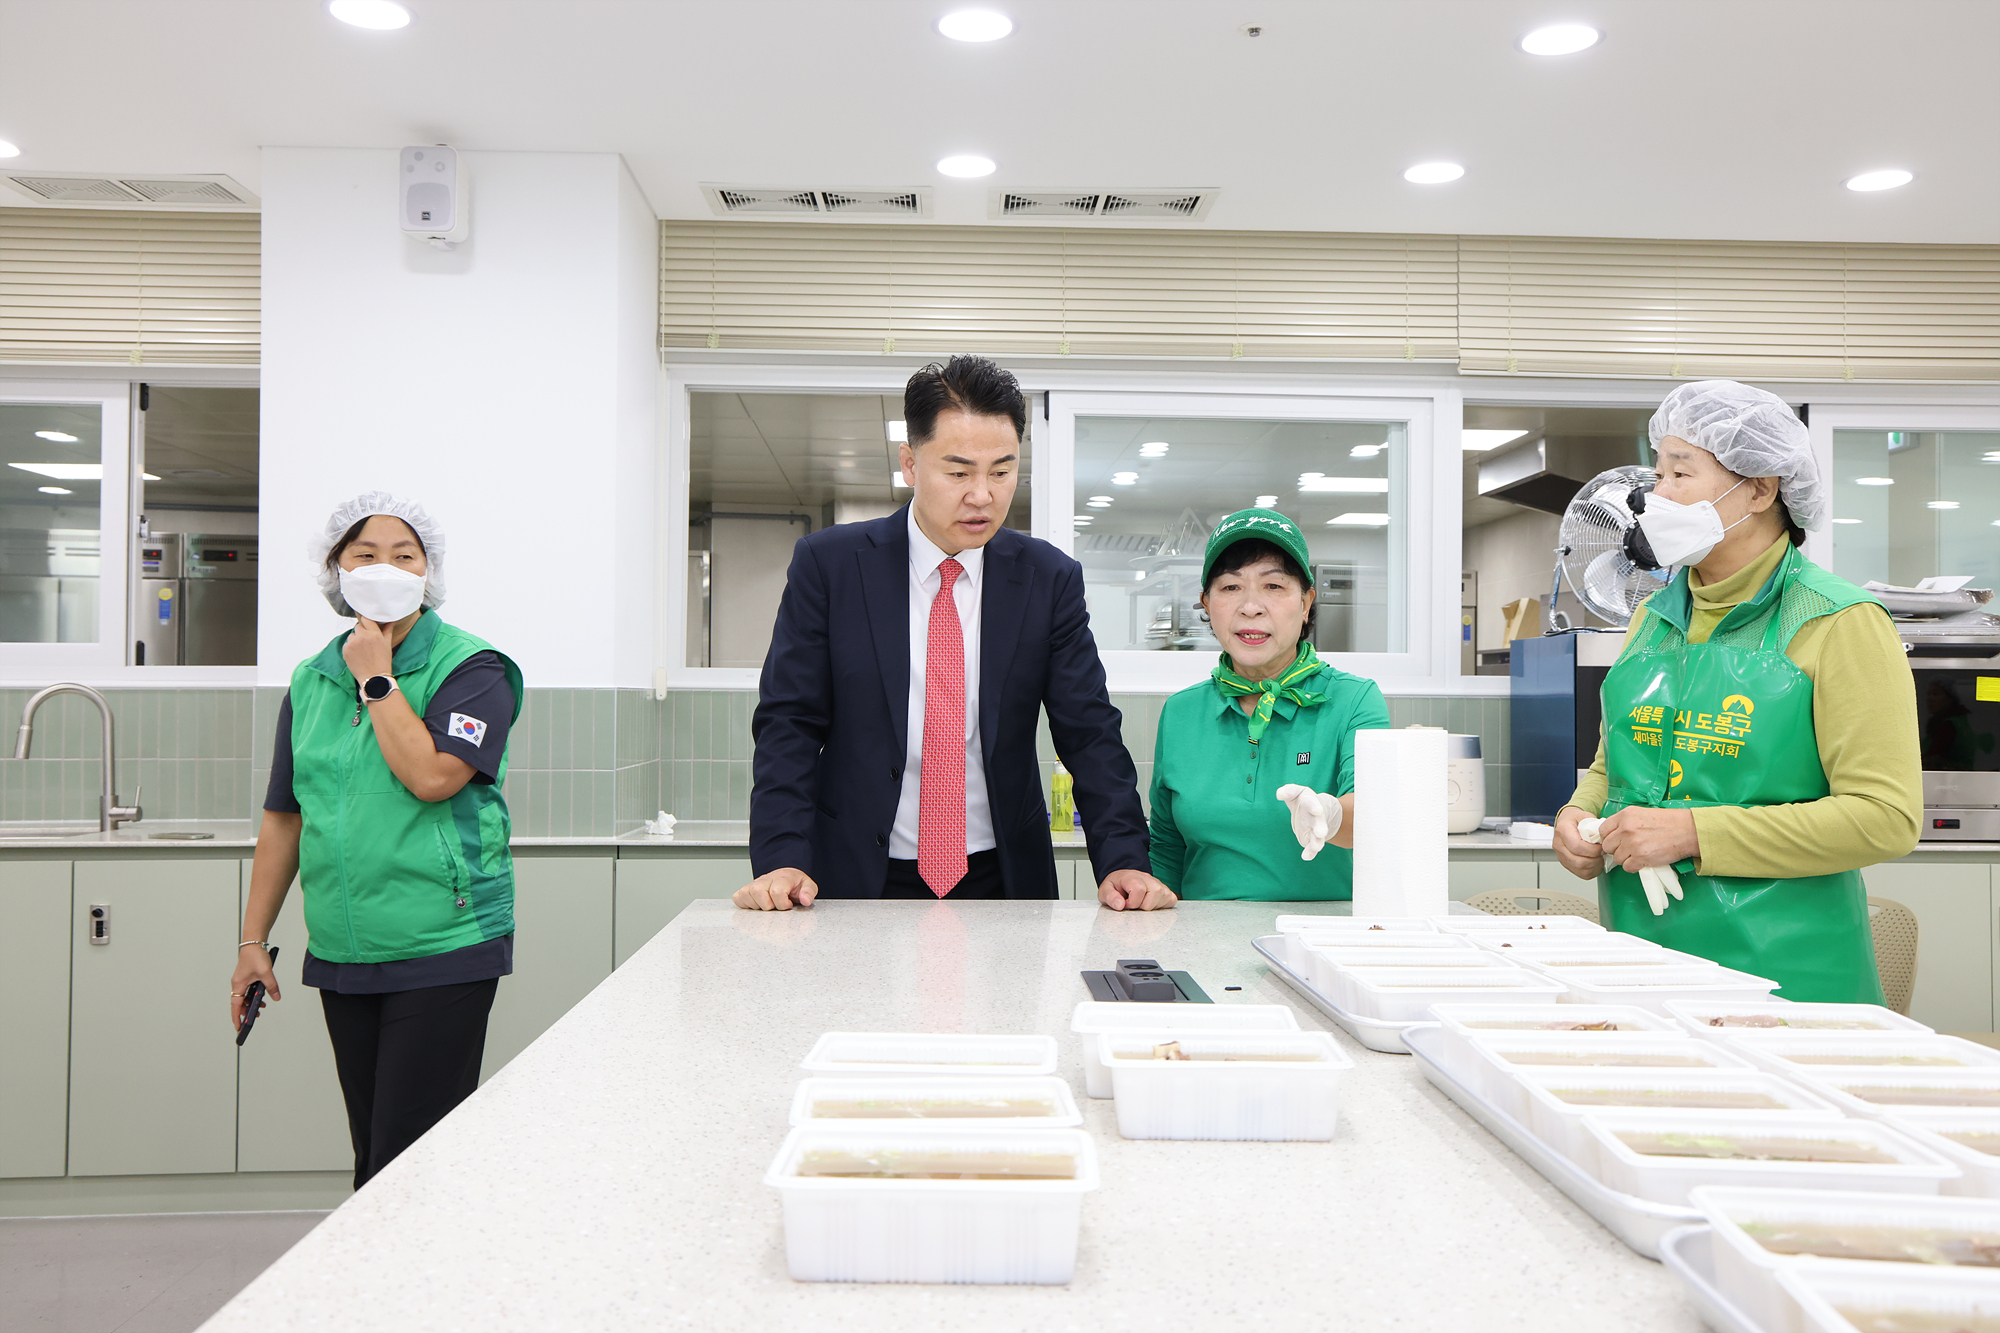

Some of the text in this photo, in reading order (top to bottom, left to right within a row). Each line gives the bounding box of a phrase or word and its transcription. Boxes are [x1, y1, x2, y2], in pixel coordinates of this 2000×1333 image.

[1213, 518, 1245, 539] New
[1628, 705, 1752, 738] 서울특시 도봉구
[1674, 737, 1740, 758] 도봉구지회
